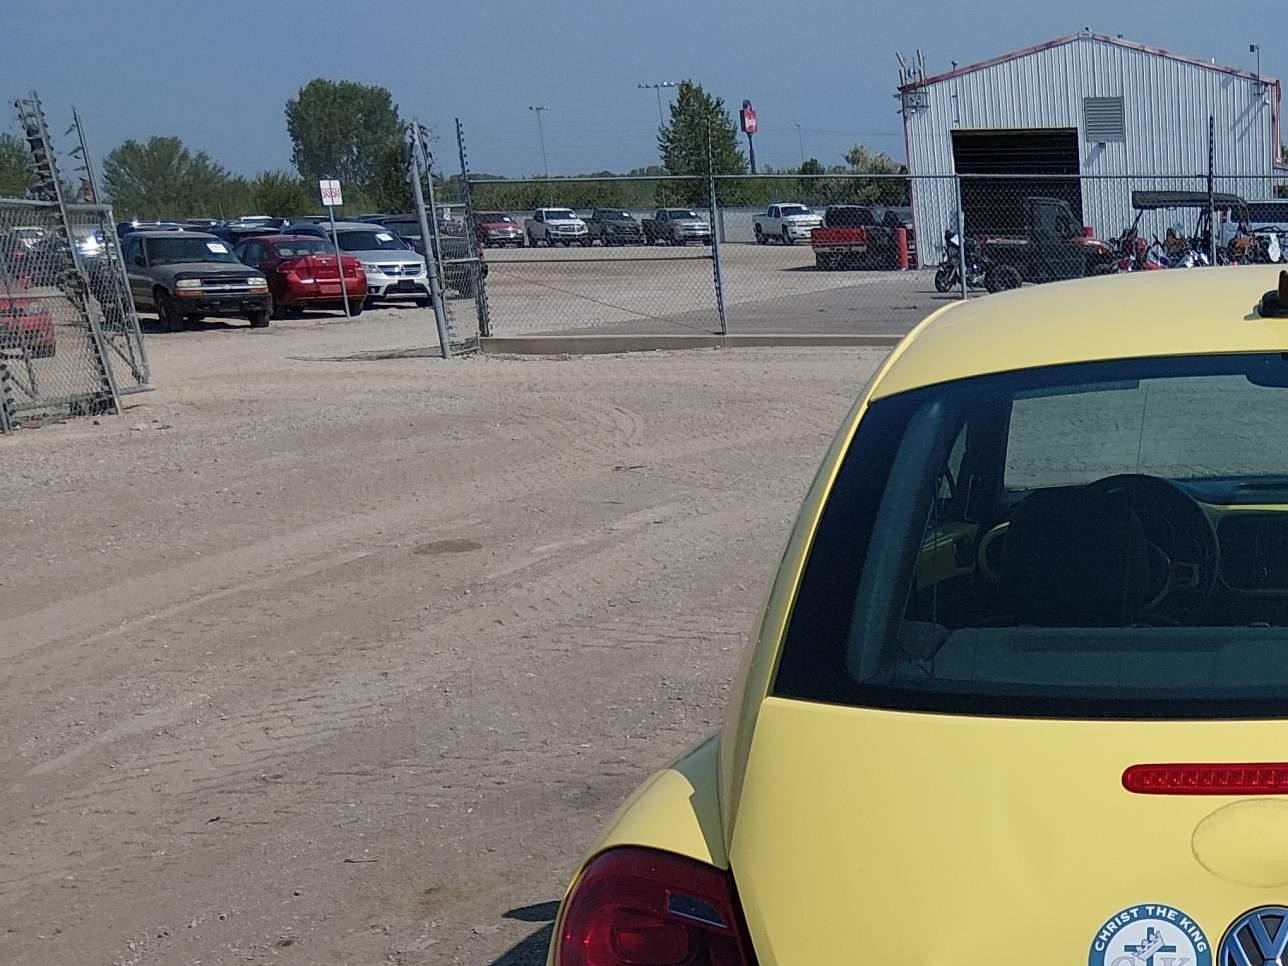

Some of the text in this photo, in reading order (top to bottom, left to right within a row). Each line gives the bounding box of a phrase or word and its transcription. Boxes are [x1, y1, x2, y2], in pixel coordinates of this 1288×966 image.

[1095, 906, 1207, 953] CHRIST THE KING
